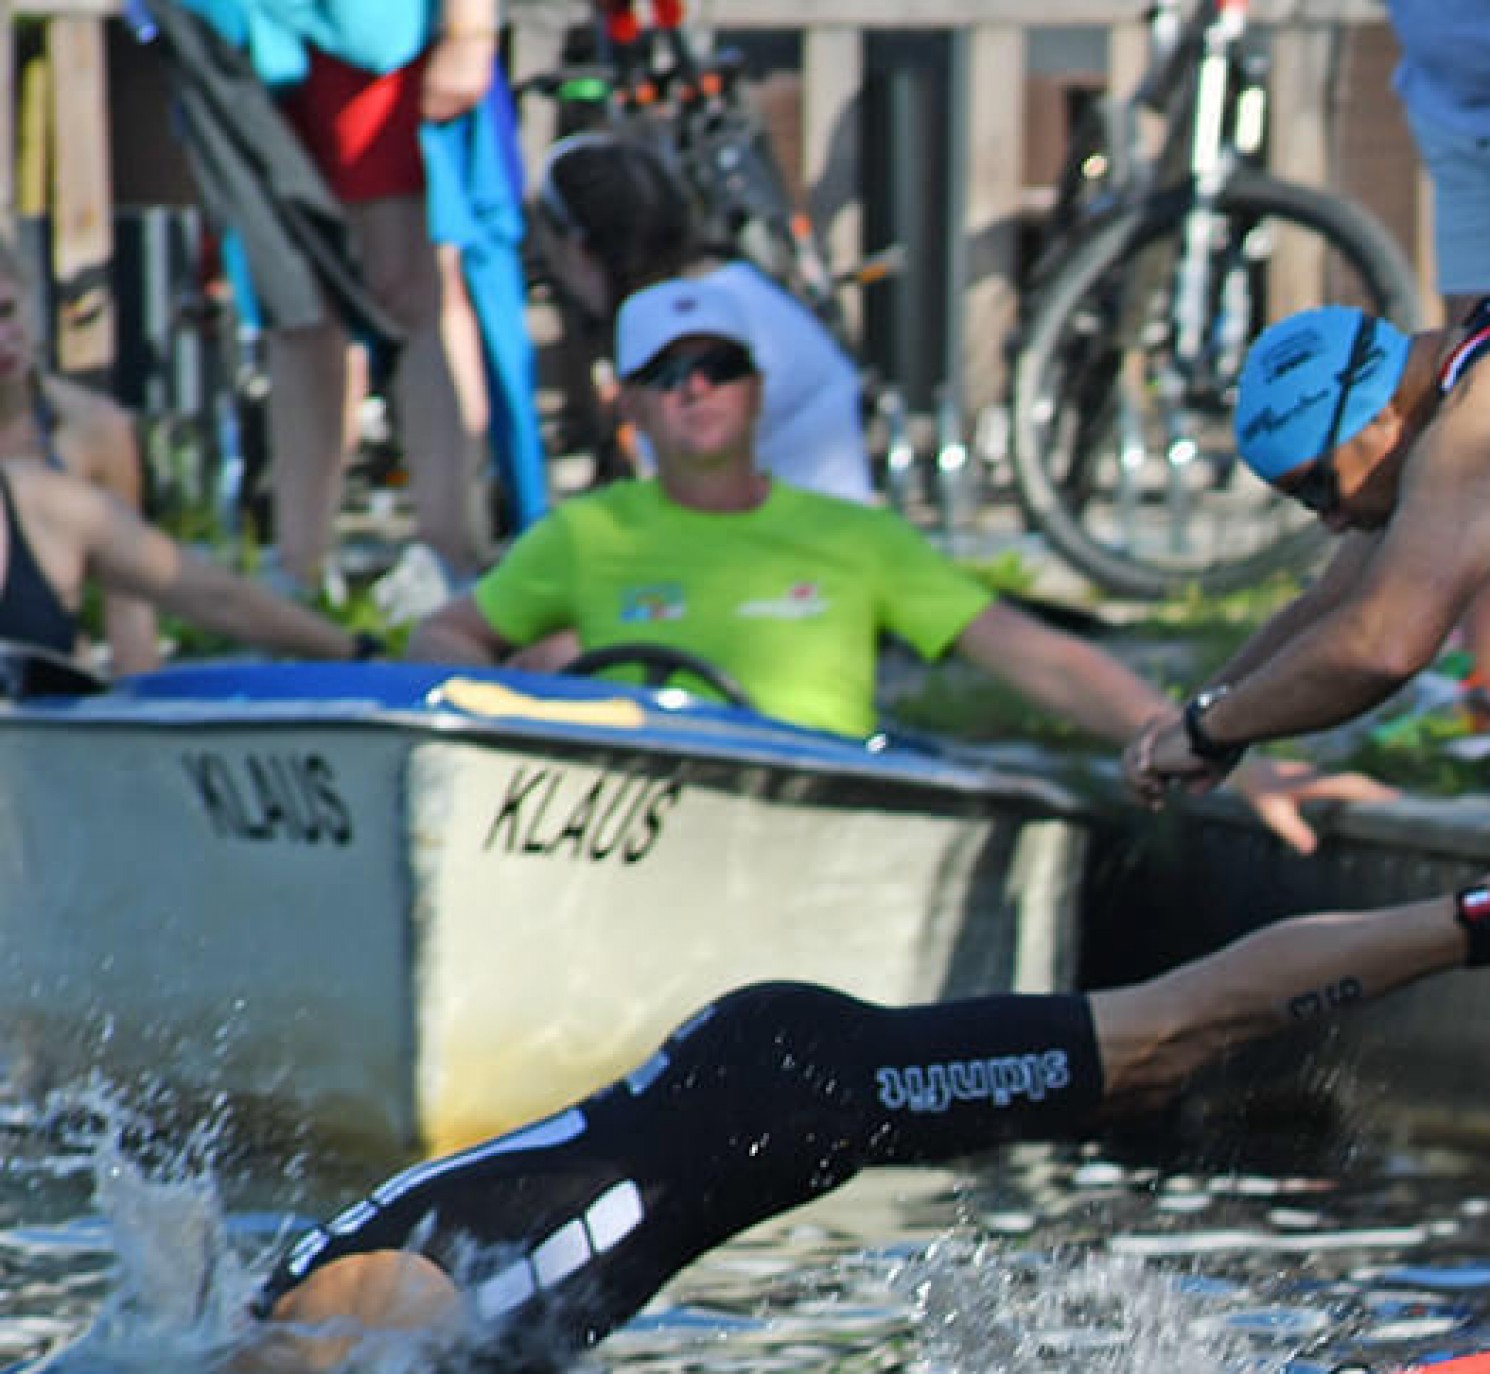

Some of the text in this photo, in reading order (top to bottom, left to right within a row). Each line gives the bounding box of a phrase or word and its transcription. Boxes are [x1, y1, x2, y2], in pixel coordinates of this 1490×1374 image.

[180, 751, 353, 848] KLAUS
[482, 765, 685, 865] KLAUS
[874, 1048, 1071, 1113] skinfit
